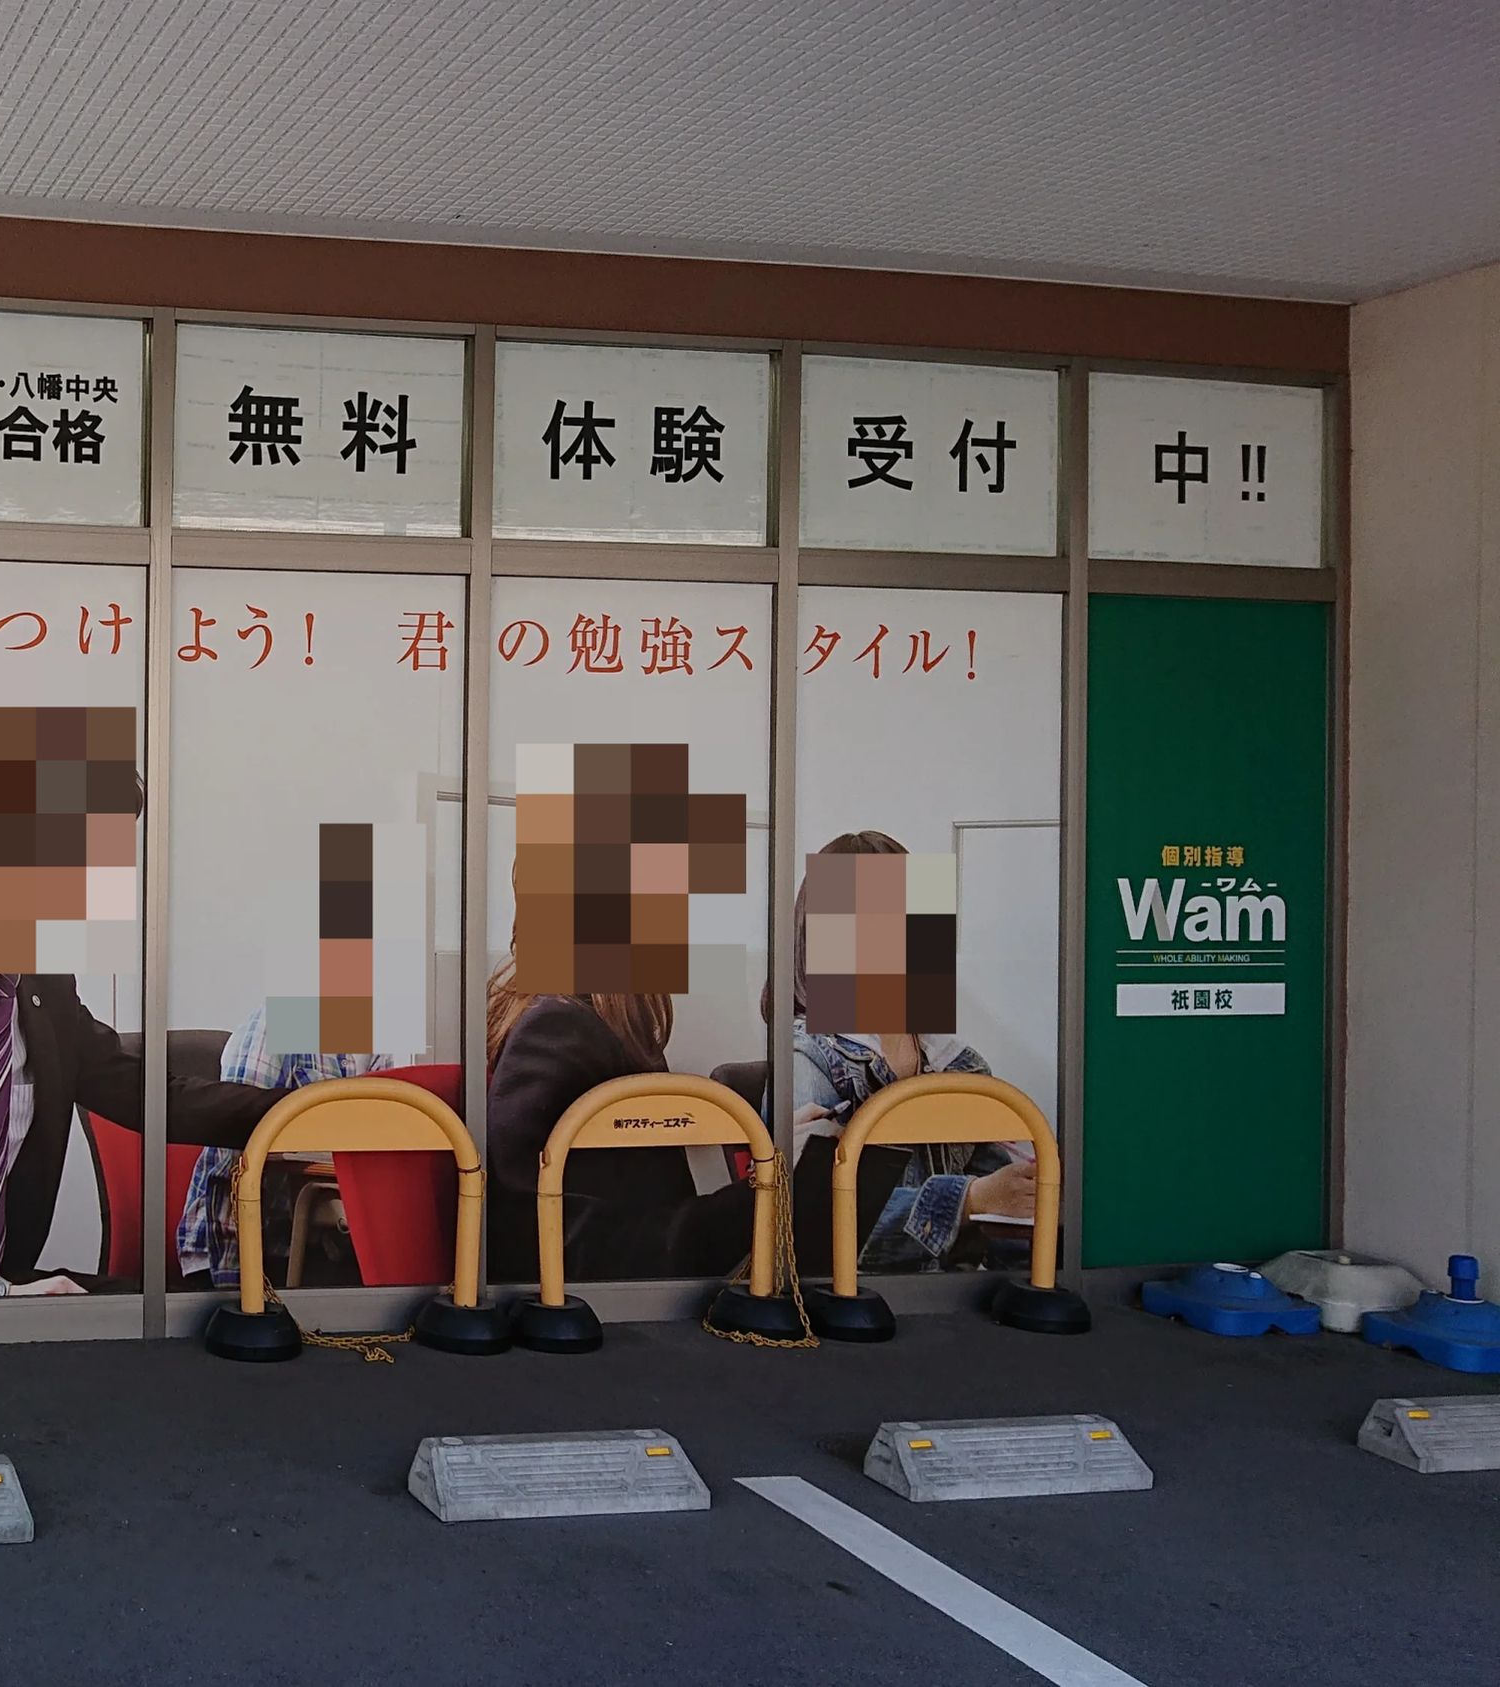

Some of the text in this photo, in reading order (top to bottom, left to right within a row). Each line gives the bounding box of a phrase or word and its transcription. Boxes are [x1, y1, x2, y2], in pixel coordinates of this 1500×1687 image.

[228, 384, 417, 475] 無料
[541, 399, 726, 484] 体験
[847, 415, 1017, 494] 受付
[1161, 845, 1244, 868] 個別指導
[1117, 877, 1287, 942] Wam
[1152, 953, 1251, 963] WHOLE ABILITY MAKING
[1171, 988, 1234, 1011] 祇園校
